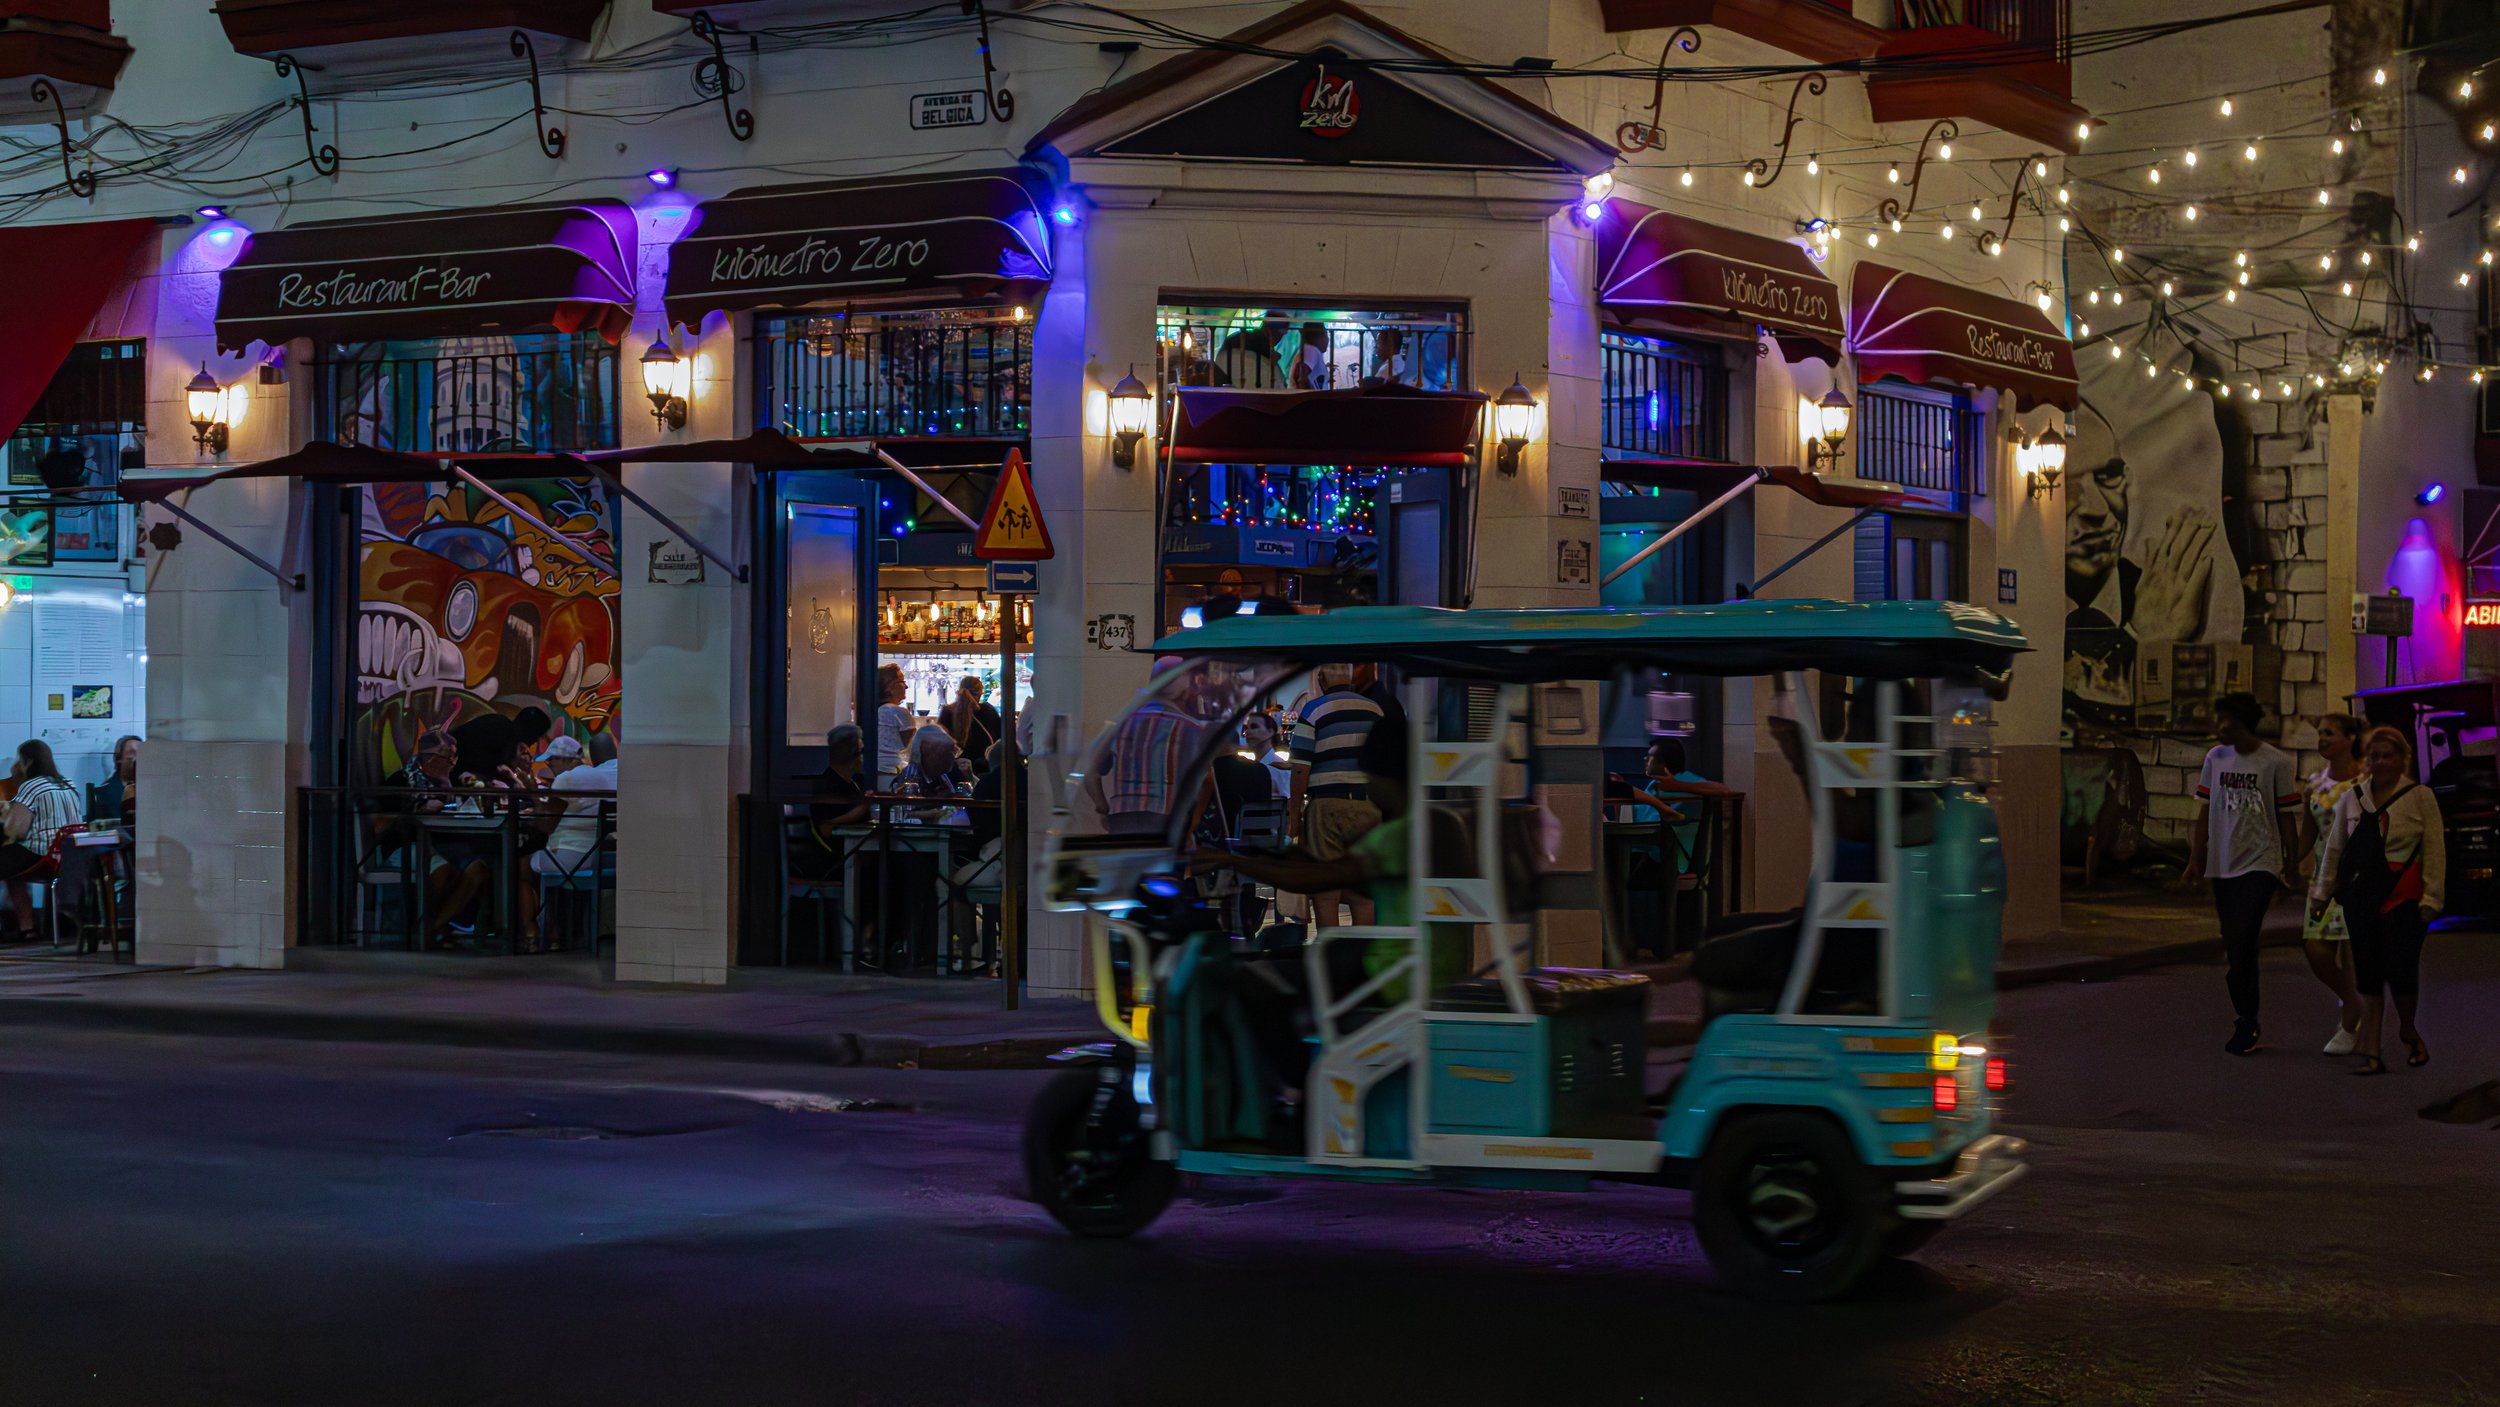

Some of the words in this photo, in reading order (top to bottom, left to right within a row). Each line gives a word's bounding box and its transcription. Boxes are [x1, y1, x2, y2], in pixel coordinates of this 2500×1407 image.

[851, 236, 929, 271] Zero
[278, 265, 492, 309] Restaurant-Bar
[1791, 286, 1828, 321] Zero
[1966, 324, 2055, 371] Restaurant-Bar
[1106, 626, 1126, 639] 437
[2464, 605, 2500, 625] ABI
